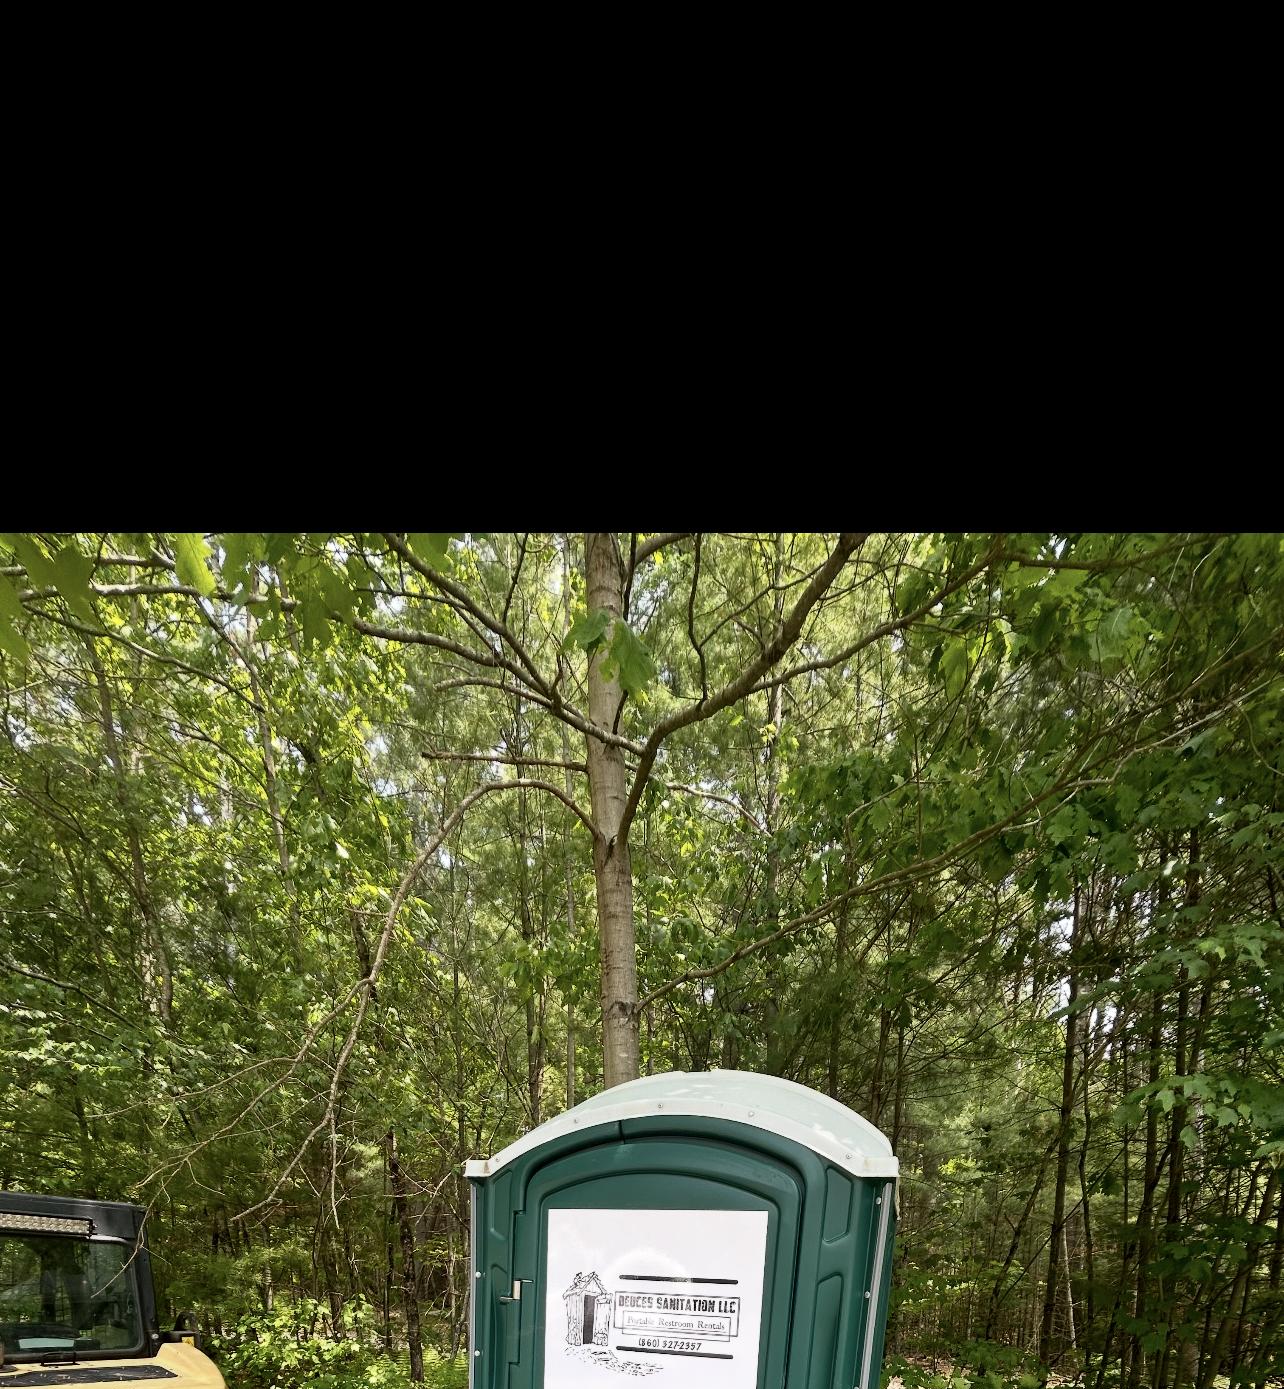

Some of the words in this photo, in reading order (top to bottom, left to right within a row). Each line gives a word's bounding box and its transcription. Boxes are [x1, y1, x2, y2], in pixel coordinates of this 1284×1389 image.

[618, 1295, 654, 1309] DEUCES
[656, 1296, 715, 1313] SANITATION
[718, 1300, 737, 1314] LLC
[627, 1315, 655, 1326] Portable
[658, 1317, 694, 1328] Restroom
[697, 1320, 725, 1331] Rentals
[638, 1337, 660, 1347] (860)
[662, 1340, 702, 1351] 327-2357
